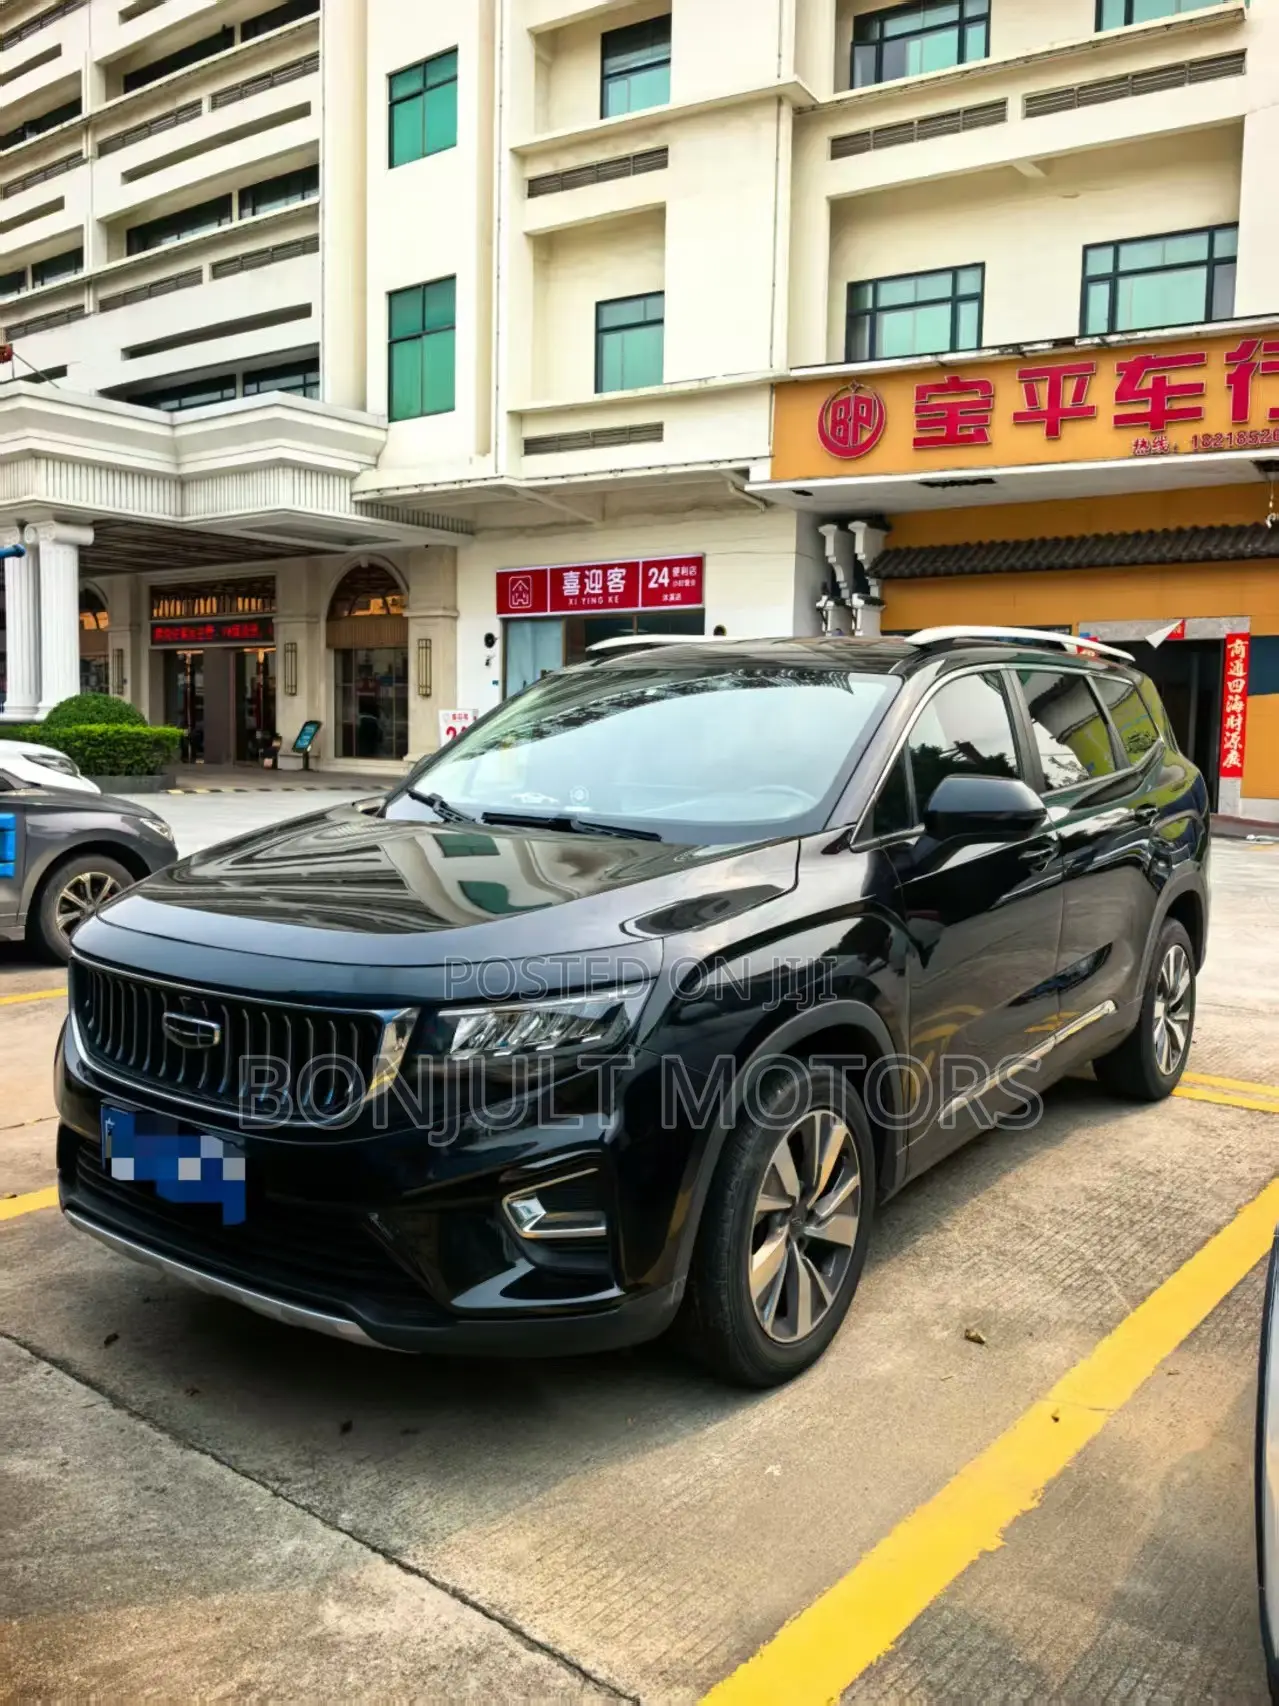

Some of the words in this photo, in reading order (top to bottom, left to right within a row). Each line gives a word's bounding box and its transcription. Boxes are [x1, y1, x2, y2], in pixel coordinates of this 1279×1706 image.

[562, 566, 626, 596] 喜迎客
[647, 566, 670, 589] 24
[581, 596, 603, 605] YING
[608, 595, 619, 604] KE
